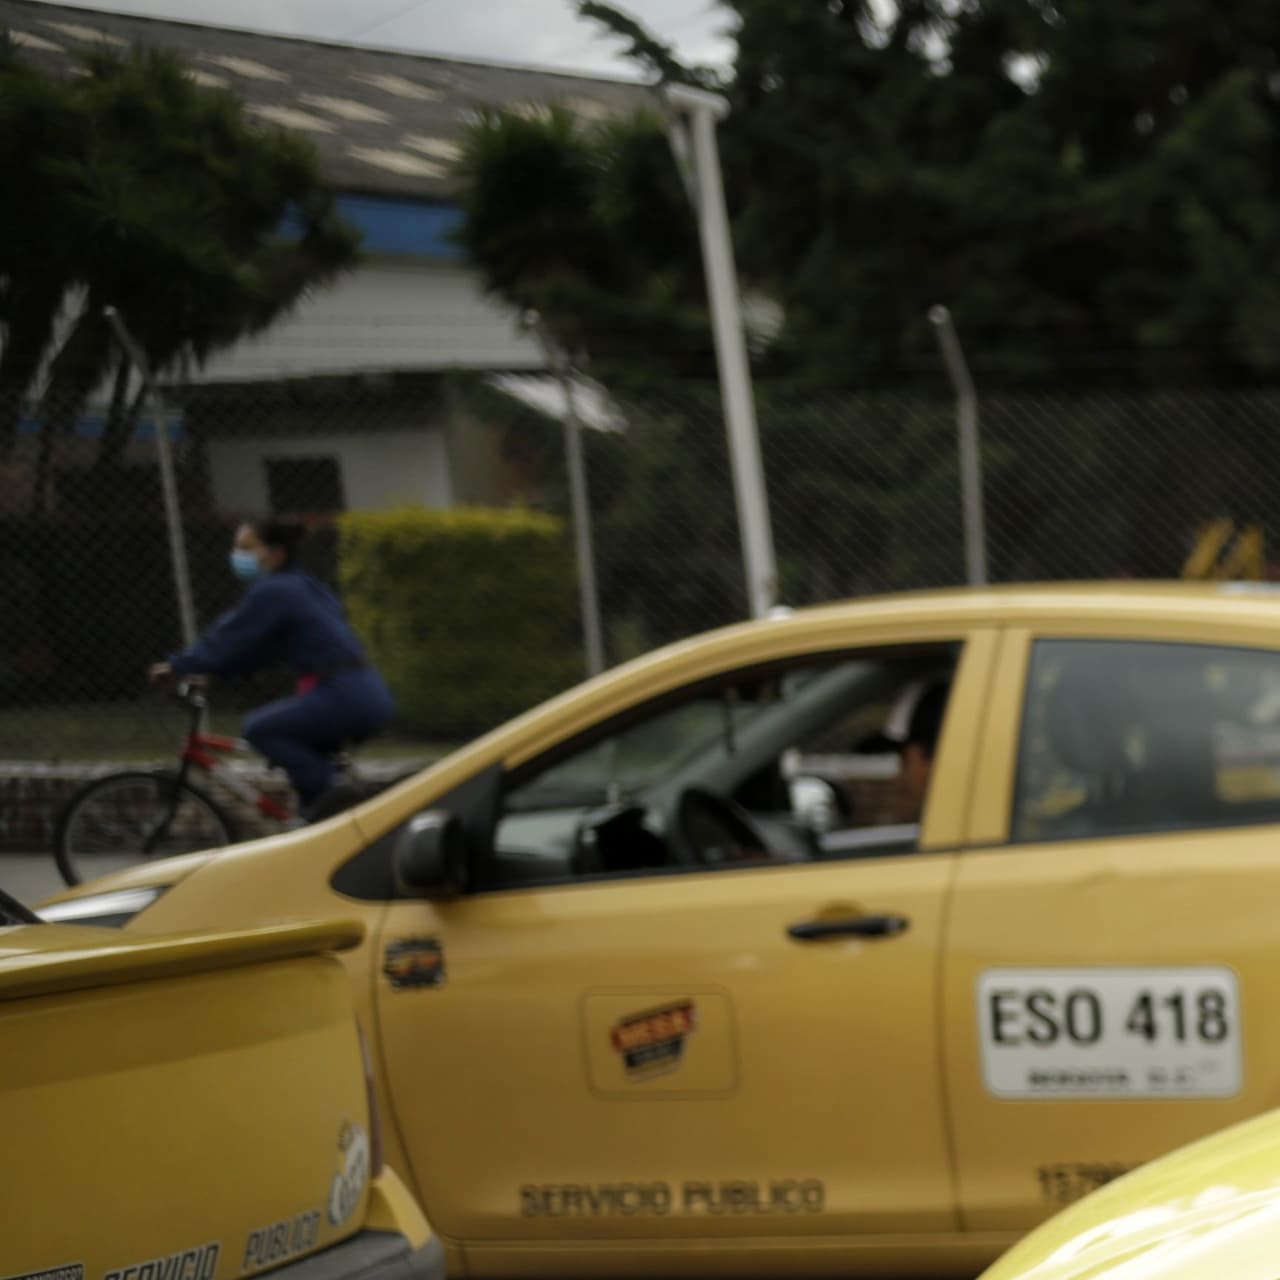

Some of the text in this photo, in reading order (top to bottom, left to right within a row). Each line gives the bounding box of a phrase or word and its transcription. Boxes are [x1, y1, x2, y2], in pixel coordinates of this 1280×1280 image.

[989, 987, 1230, 1046] ESO 418
[519, 1178, 825, 1217] SERVICIO PUBLICO
